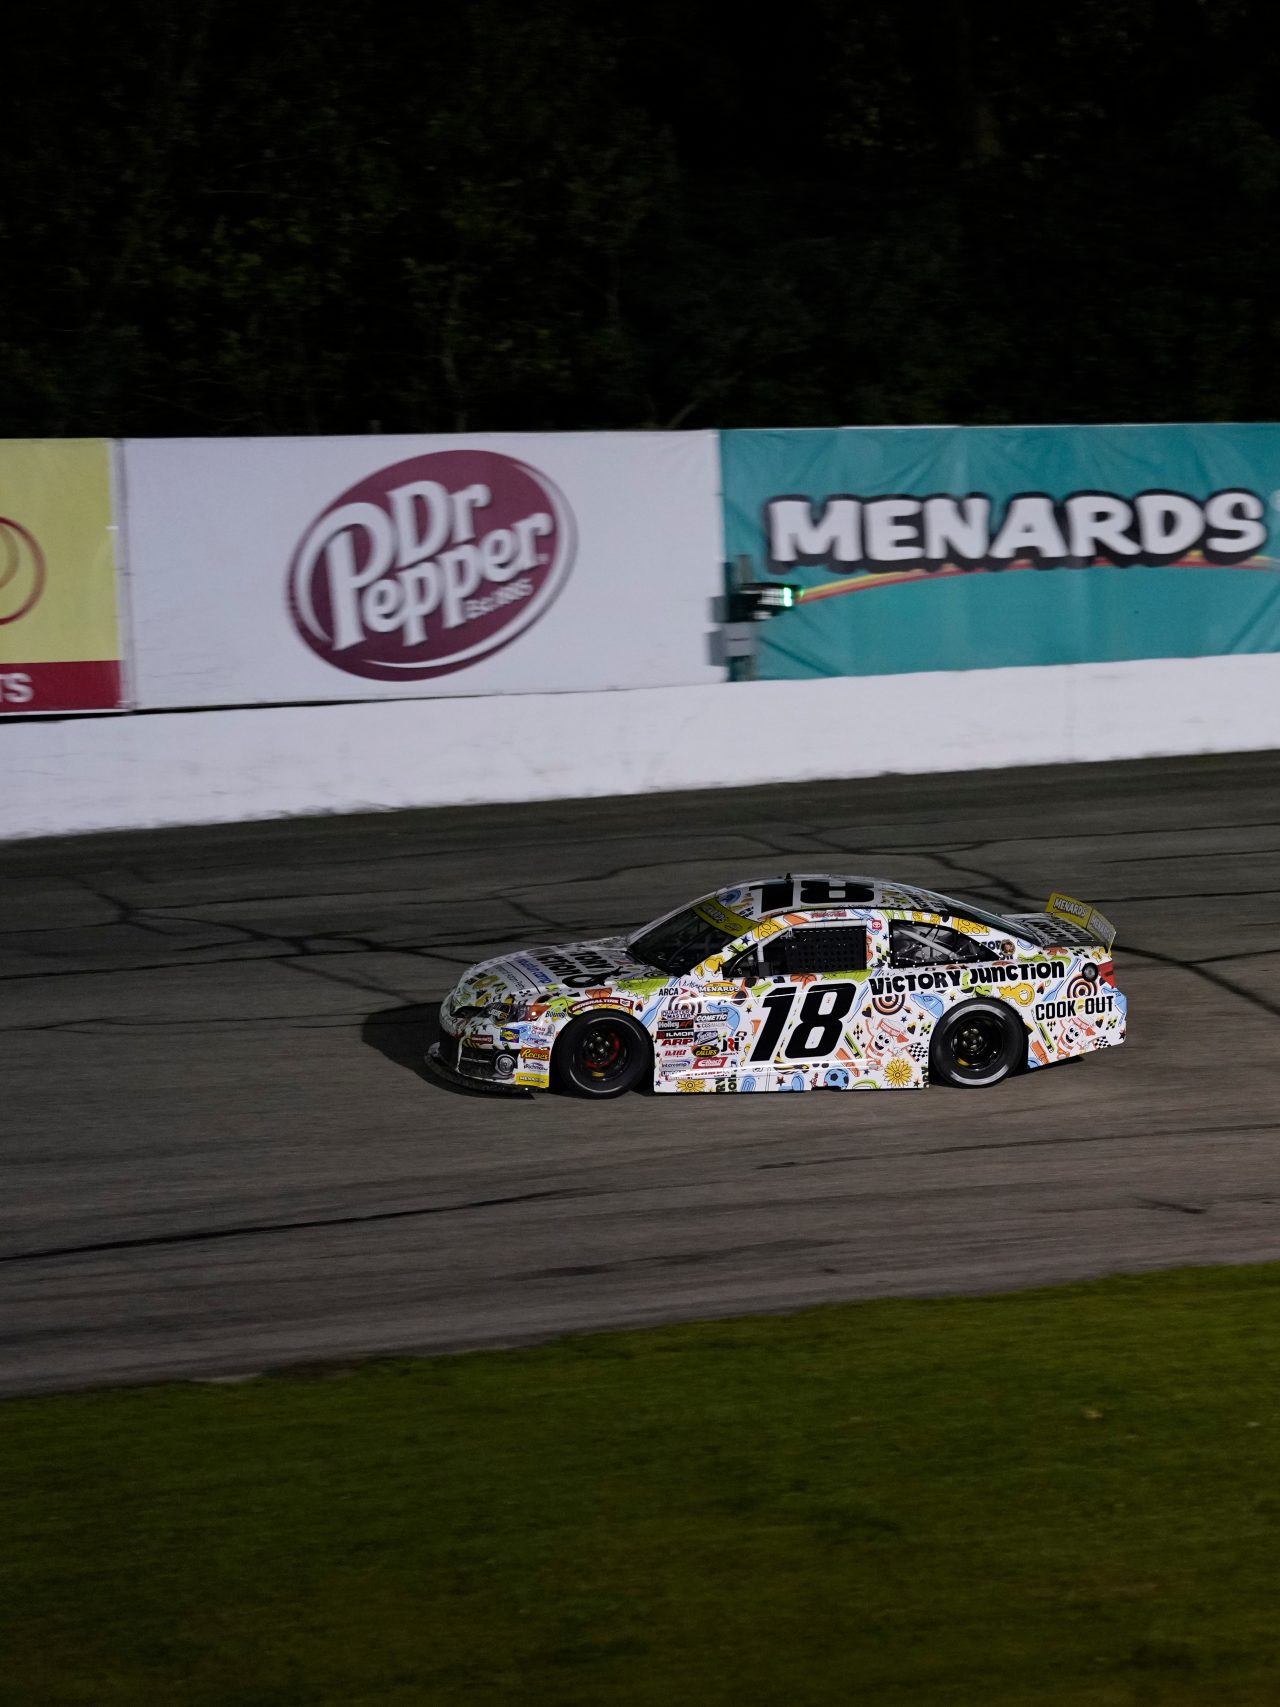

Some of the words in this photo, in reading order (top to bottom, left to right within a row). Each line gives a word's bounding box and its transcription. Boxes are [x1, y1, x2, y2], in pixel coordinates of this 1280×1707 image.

[395, 480, 493, 569] Dr
[766, 487, 1267, 567] MENARDS
[324, 502, 554, 652] Pepper
[1054, 898, 1088, 918] MENARDS
[659, 988, 679, 996] ARCA
[1035, 998, 1077, 1021] COOK
[1085, 996, 1114, 1015] OUT
[658, 1021, 680, 1029] Holley
[750, 982, 857, 1062] 18
